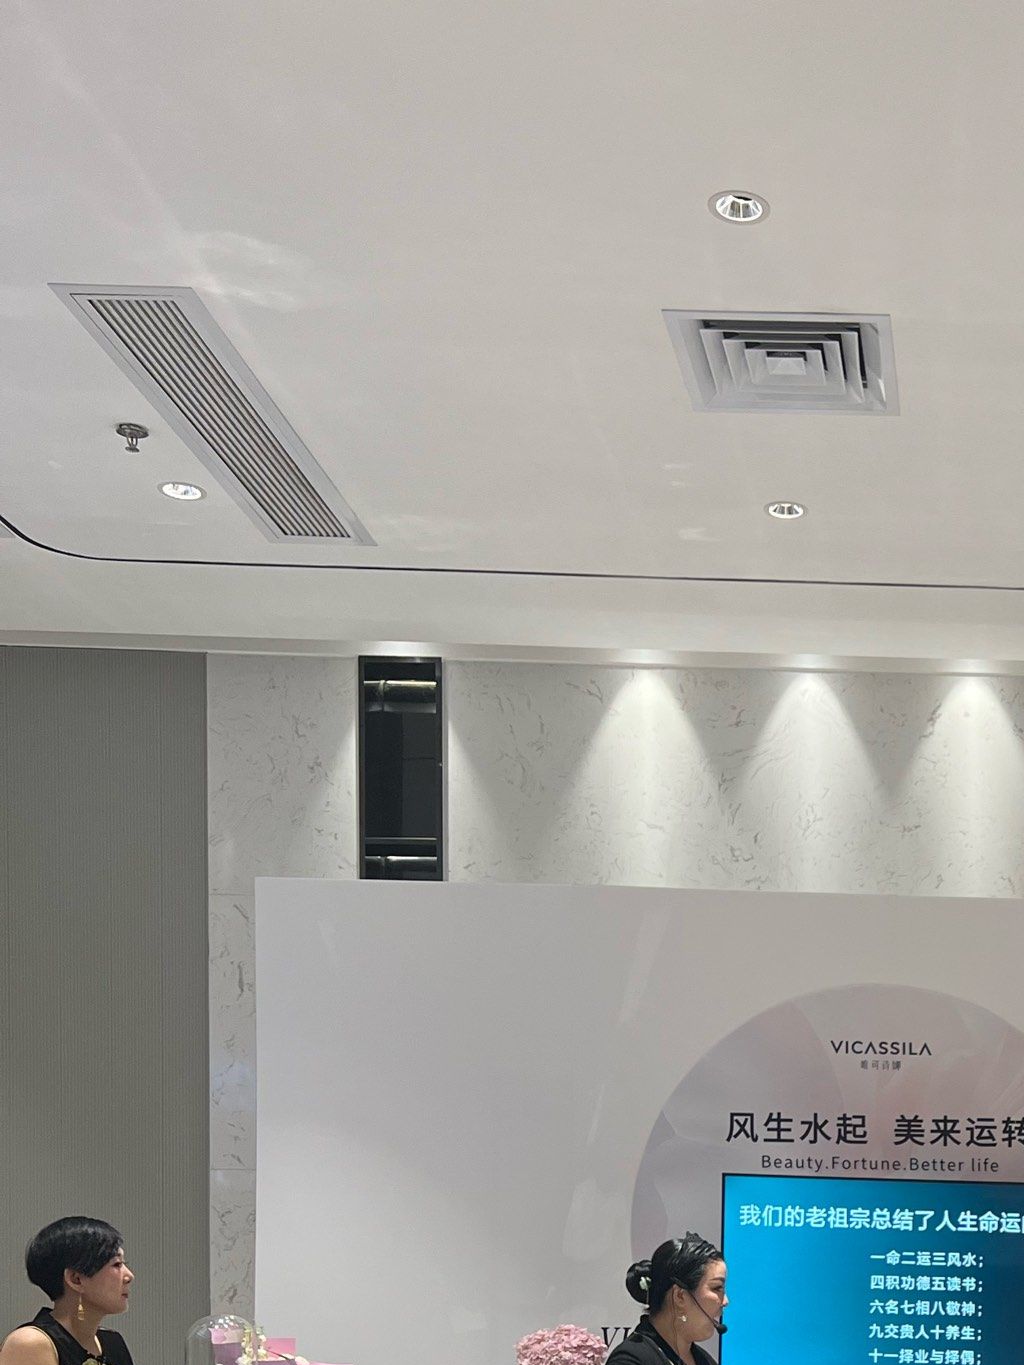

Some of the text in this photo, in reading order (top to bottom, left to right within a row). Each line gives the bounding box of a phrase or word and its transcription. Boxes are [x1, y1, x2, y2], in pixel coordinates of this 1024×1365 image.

[830, 1040, 932, 1056] VICASSILA
[725, 1112, 869, 1145] 风生水起
[971, 1157, 999, 1173] life
[870, 1250, 983, 1268] 一命二运三风水；
[870, 1275, 983, 1293] 四积功德五读书；
[869, 1299, 982, 1317] 六名七相八敬神；
[868, 1323, 982, 1341] 九交贵人十养生；
[868, 1348, 981, 1365] 十一择业与择偶；
